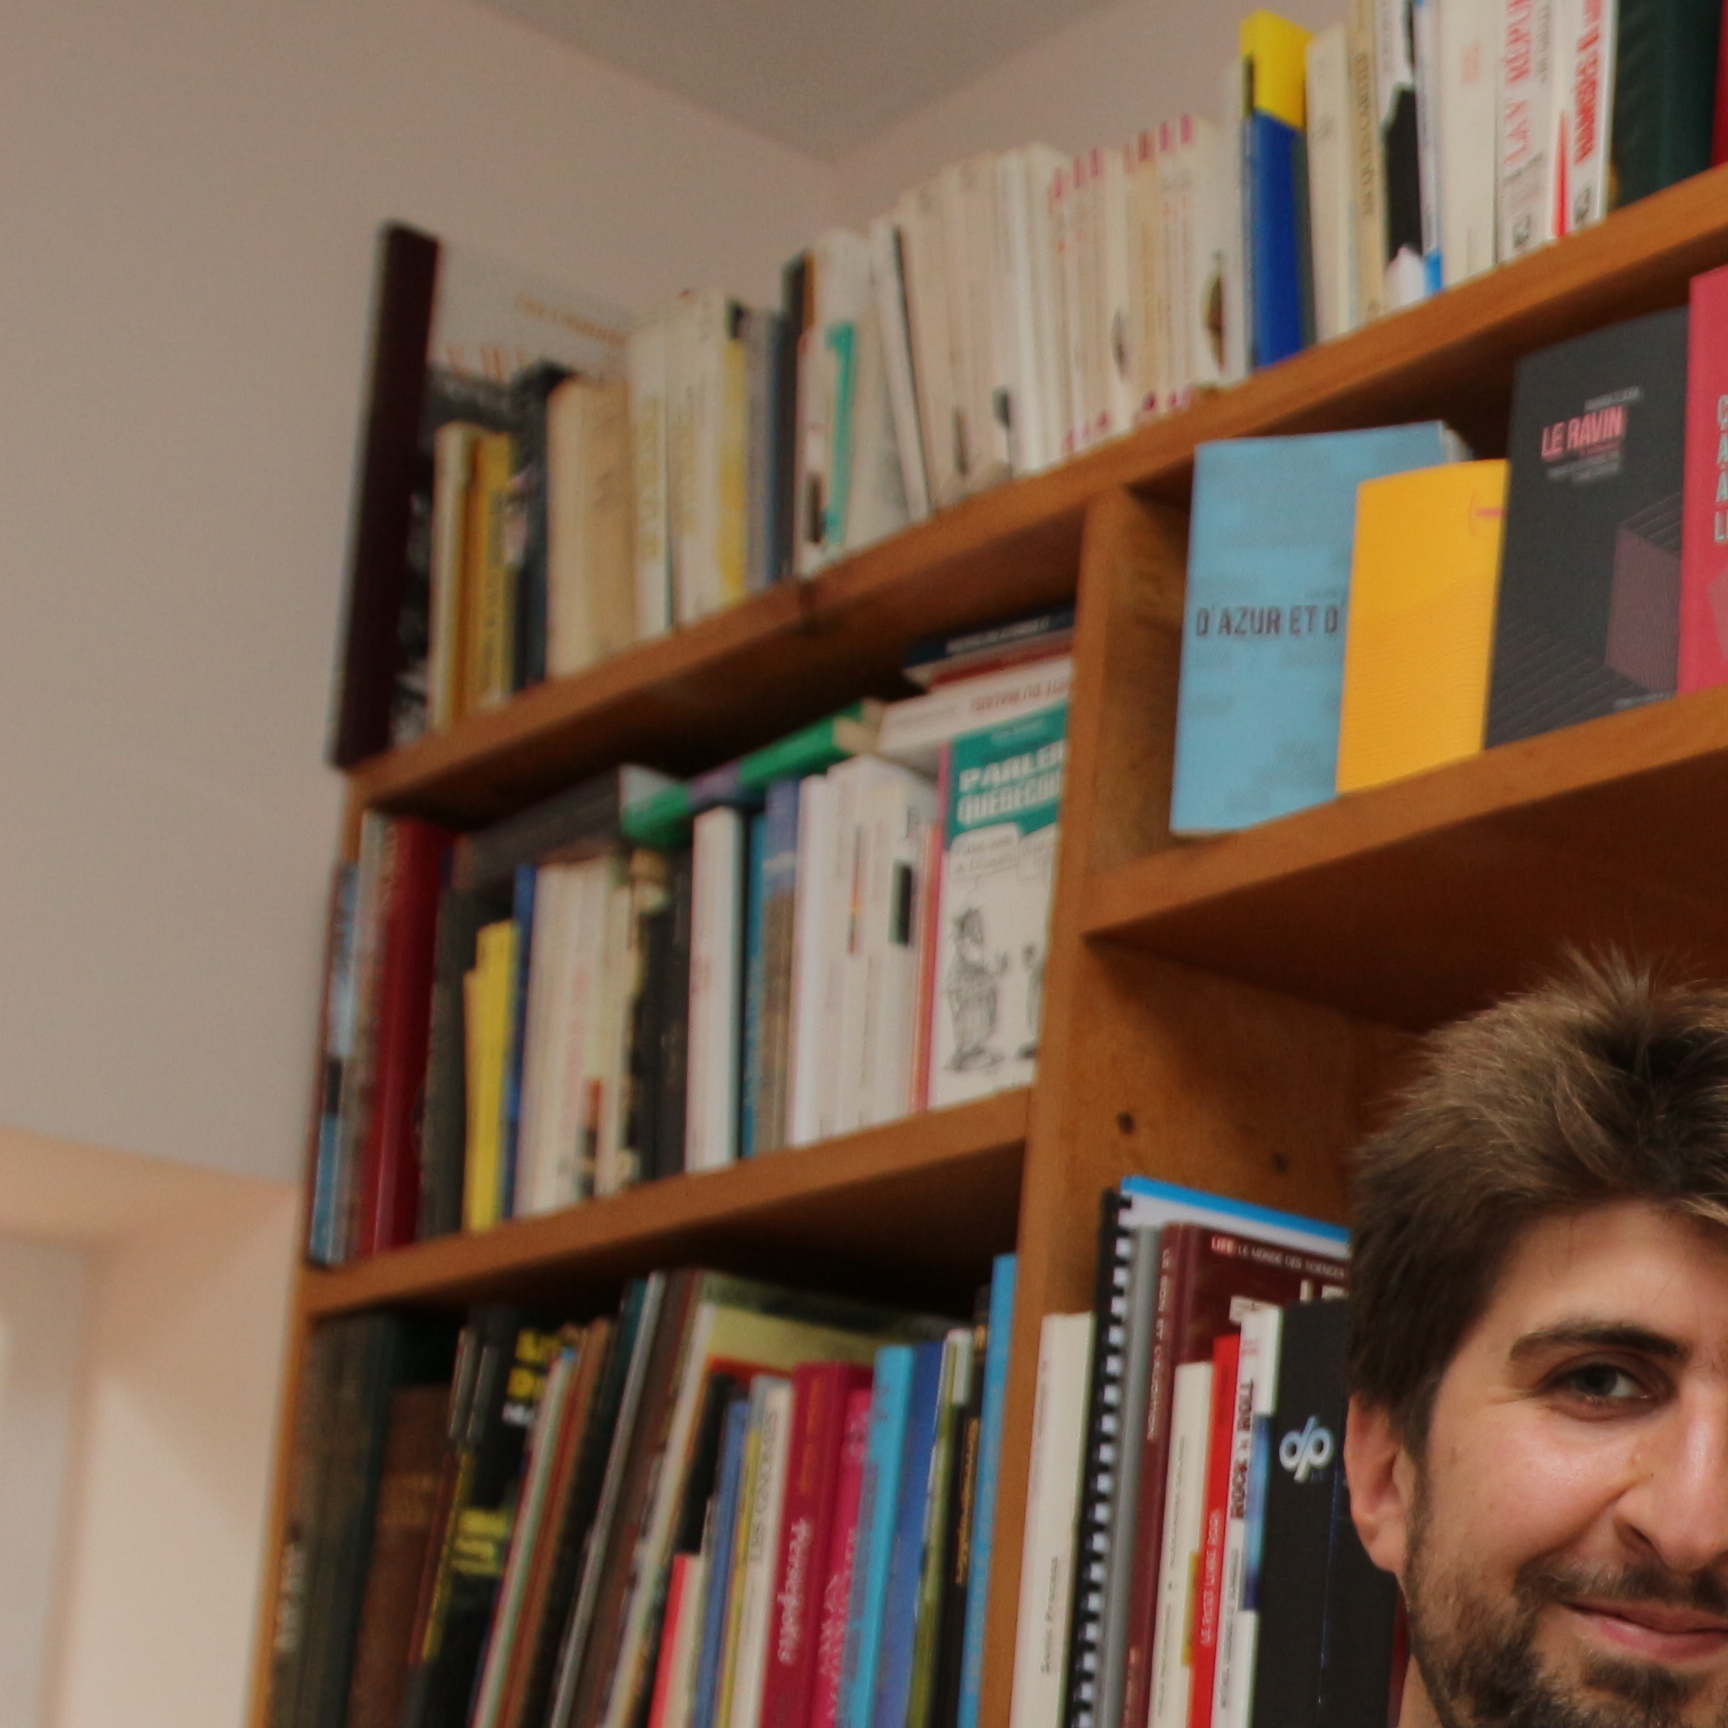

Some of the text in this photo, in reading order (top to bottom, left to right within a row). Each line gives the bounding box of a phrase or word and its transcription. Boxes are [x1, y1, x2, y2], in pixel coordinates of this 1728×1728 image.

[1541, 405, 1628, 462] LE RAVIN
[1196, 605, 1317, 638] D'AZUR ET
